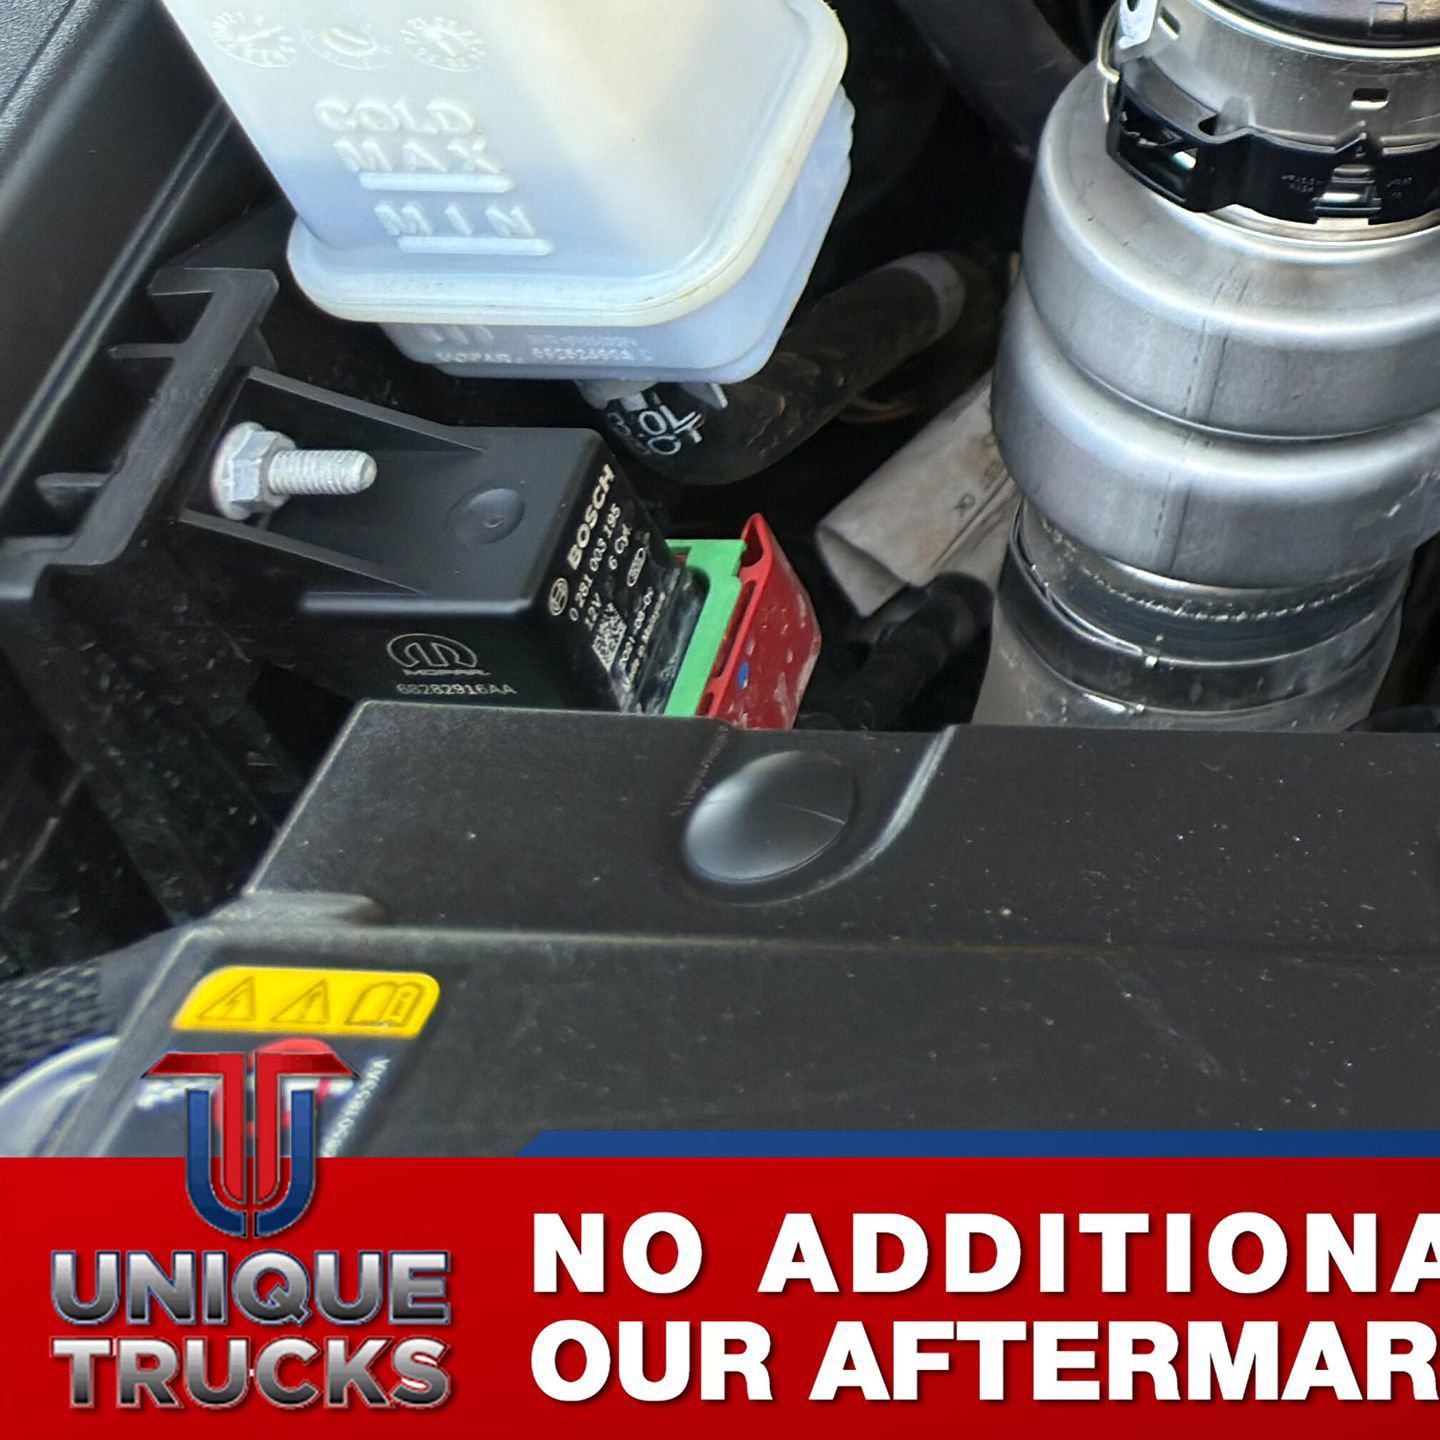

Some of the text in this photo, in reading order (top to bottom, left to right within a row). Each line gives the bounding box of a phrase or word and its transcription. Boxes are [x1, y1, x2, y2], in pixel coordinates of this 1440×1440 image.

[313, 98, 476, 135] COLD
[332, 138, 503, 173] MAX
[373, 201, 536, 238] MIN
[567, 464, 615, 571] BOSCH
[602, 502, 621, 539] 195
